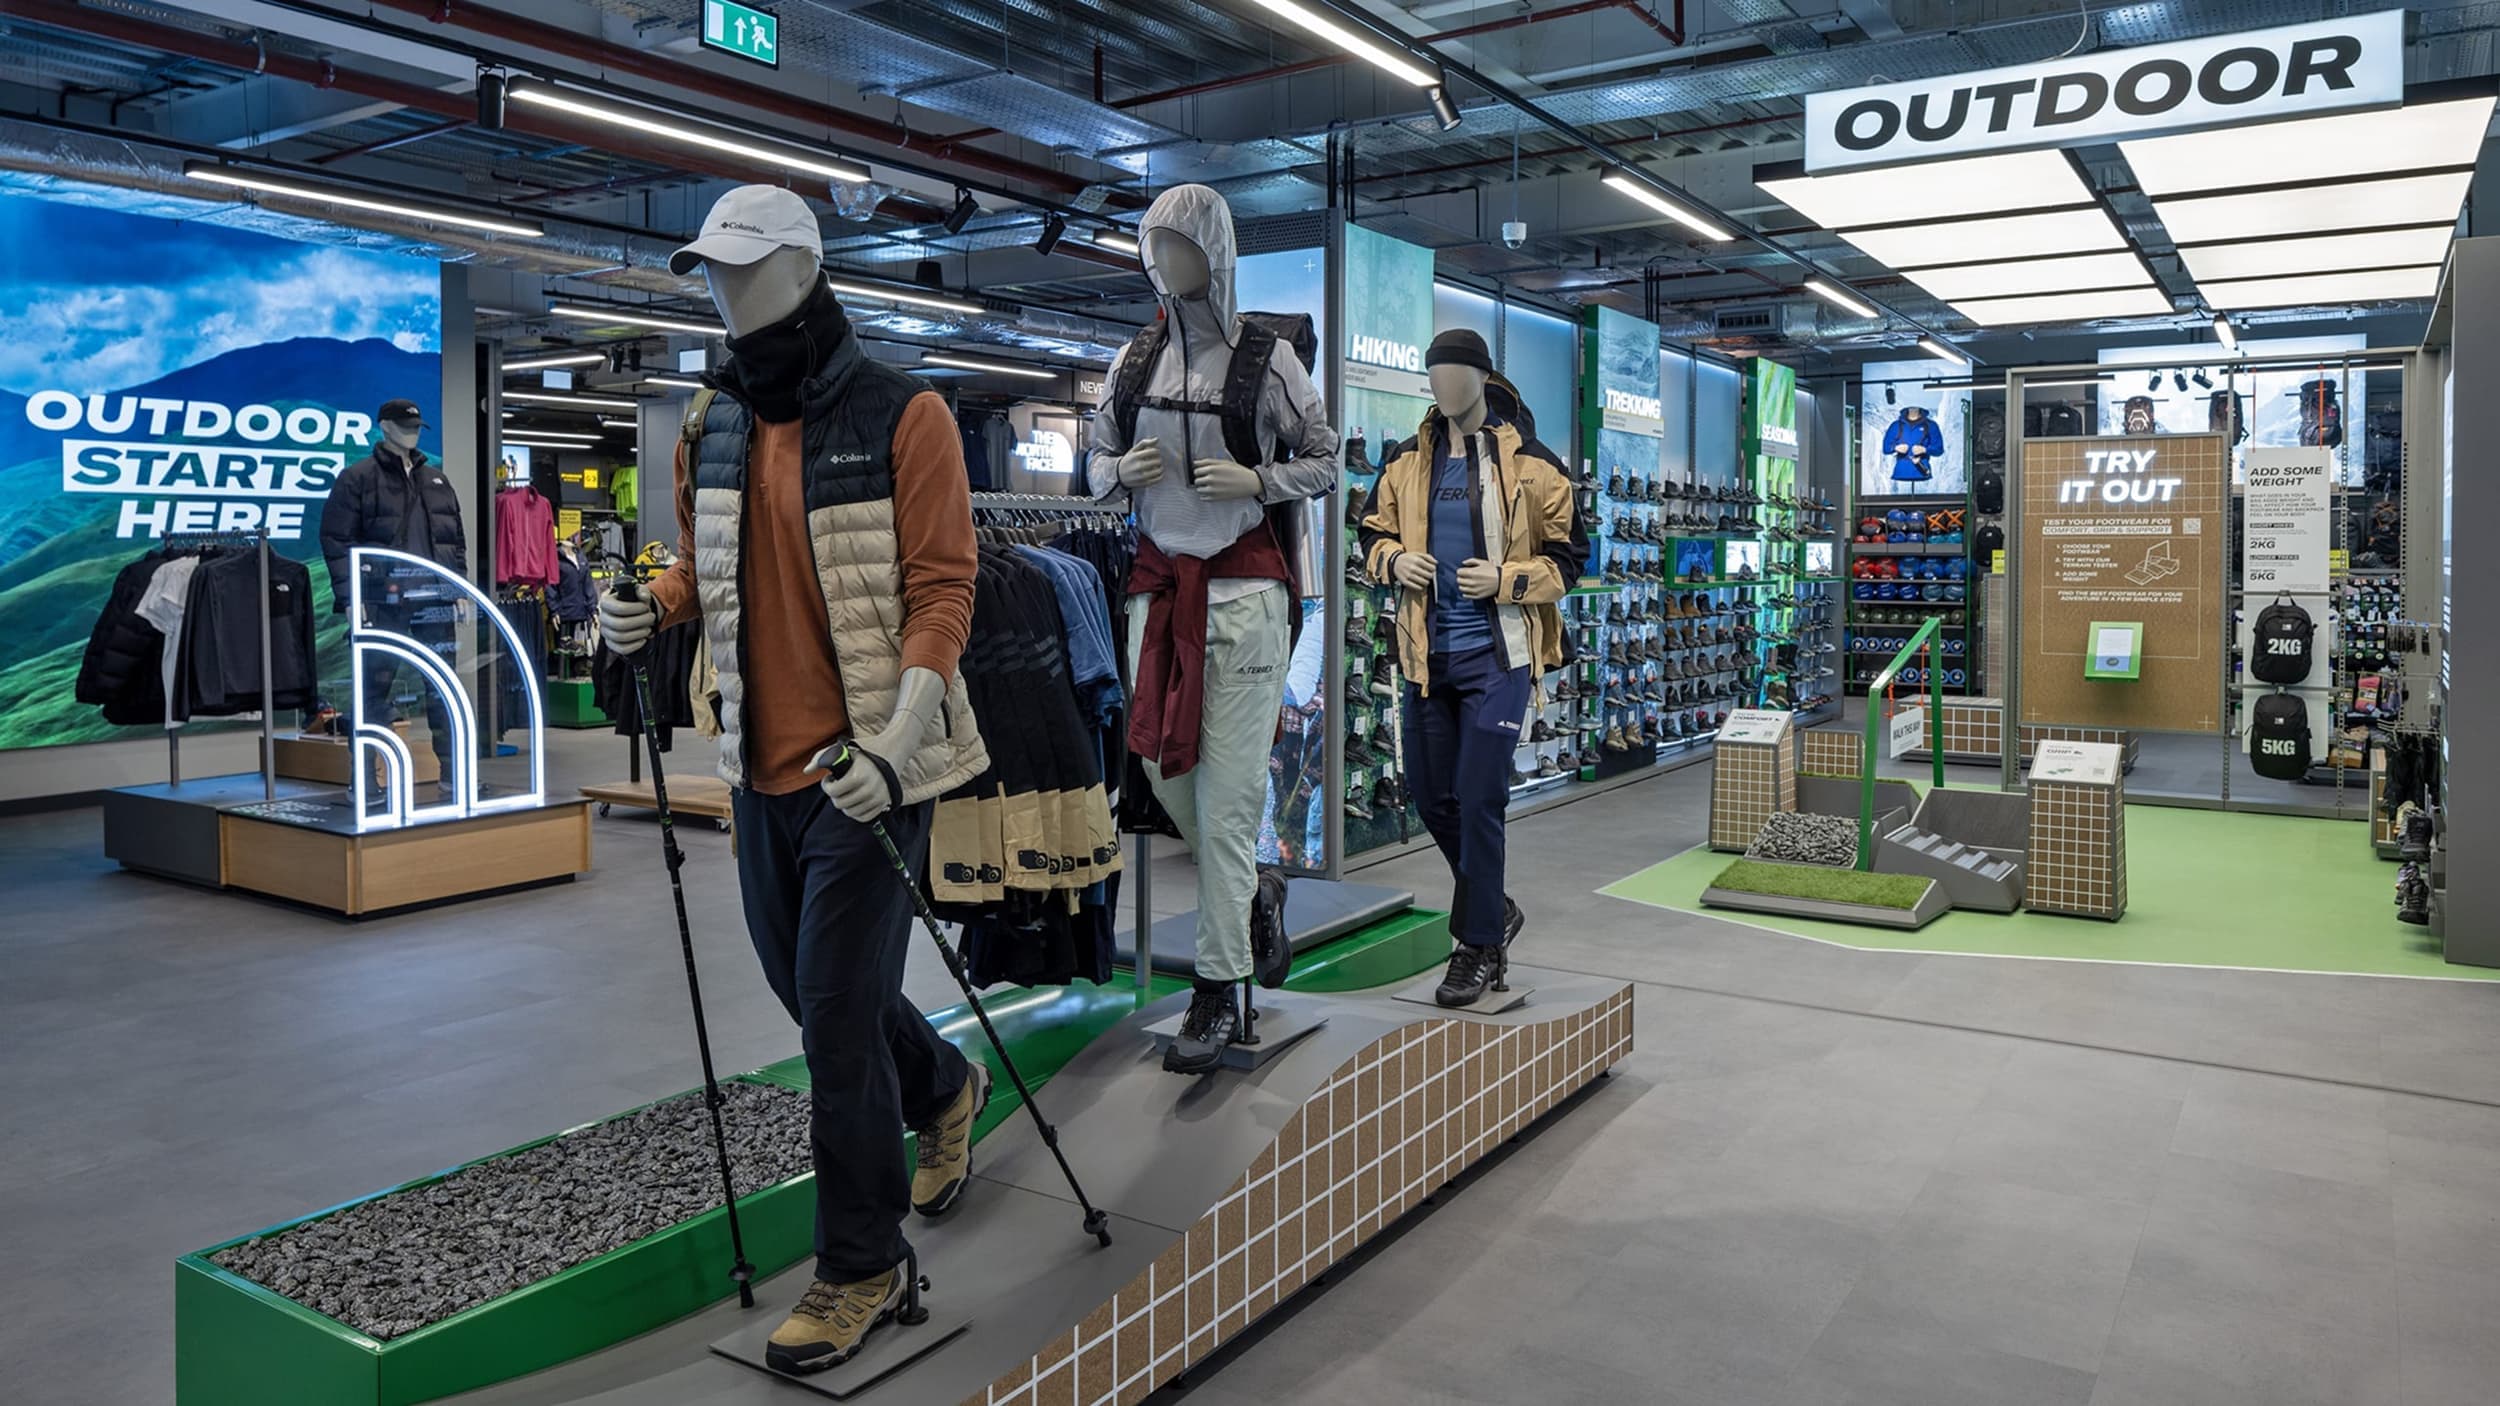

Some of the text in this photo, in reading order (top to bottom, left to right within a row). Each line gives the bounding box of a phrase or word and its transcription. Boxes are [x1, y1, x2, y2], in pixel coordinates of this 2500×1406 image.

[1833, 34, 2363, 151] OUTDOOR
[728, 221, 765, 235] Columbia
[1351, 333, 1419, 372] HIKING
[1605, 388, 1661, 420] TREKKING
[25, 390, 373, 447] OUTDOOR
[1031, 430, 1053, 444] THE
[71, 446, 339, 492] STARTS
[1026, 457, 1053, 472] FACE
[2085, 449, 2157, 474] TRY
[2249, 466, 2323, 476] ADD SOME
[2060, 478, 2181, 503] IT OUT
[2249, 477, 2304, 487] WEIGHT
[115, 500, 305, 540] HERE
[2249, 540, 2276, 549] 2KG
[2249, 572, 2275, 581] 5KG
[2267, 638, 2302, 655] 2KG
[2261, 739, 2295, 756] 5KG
